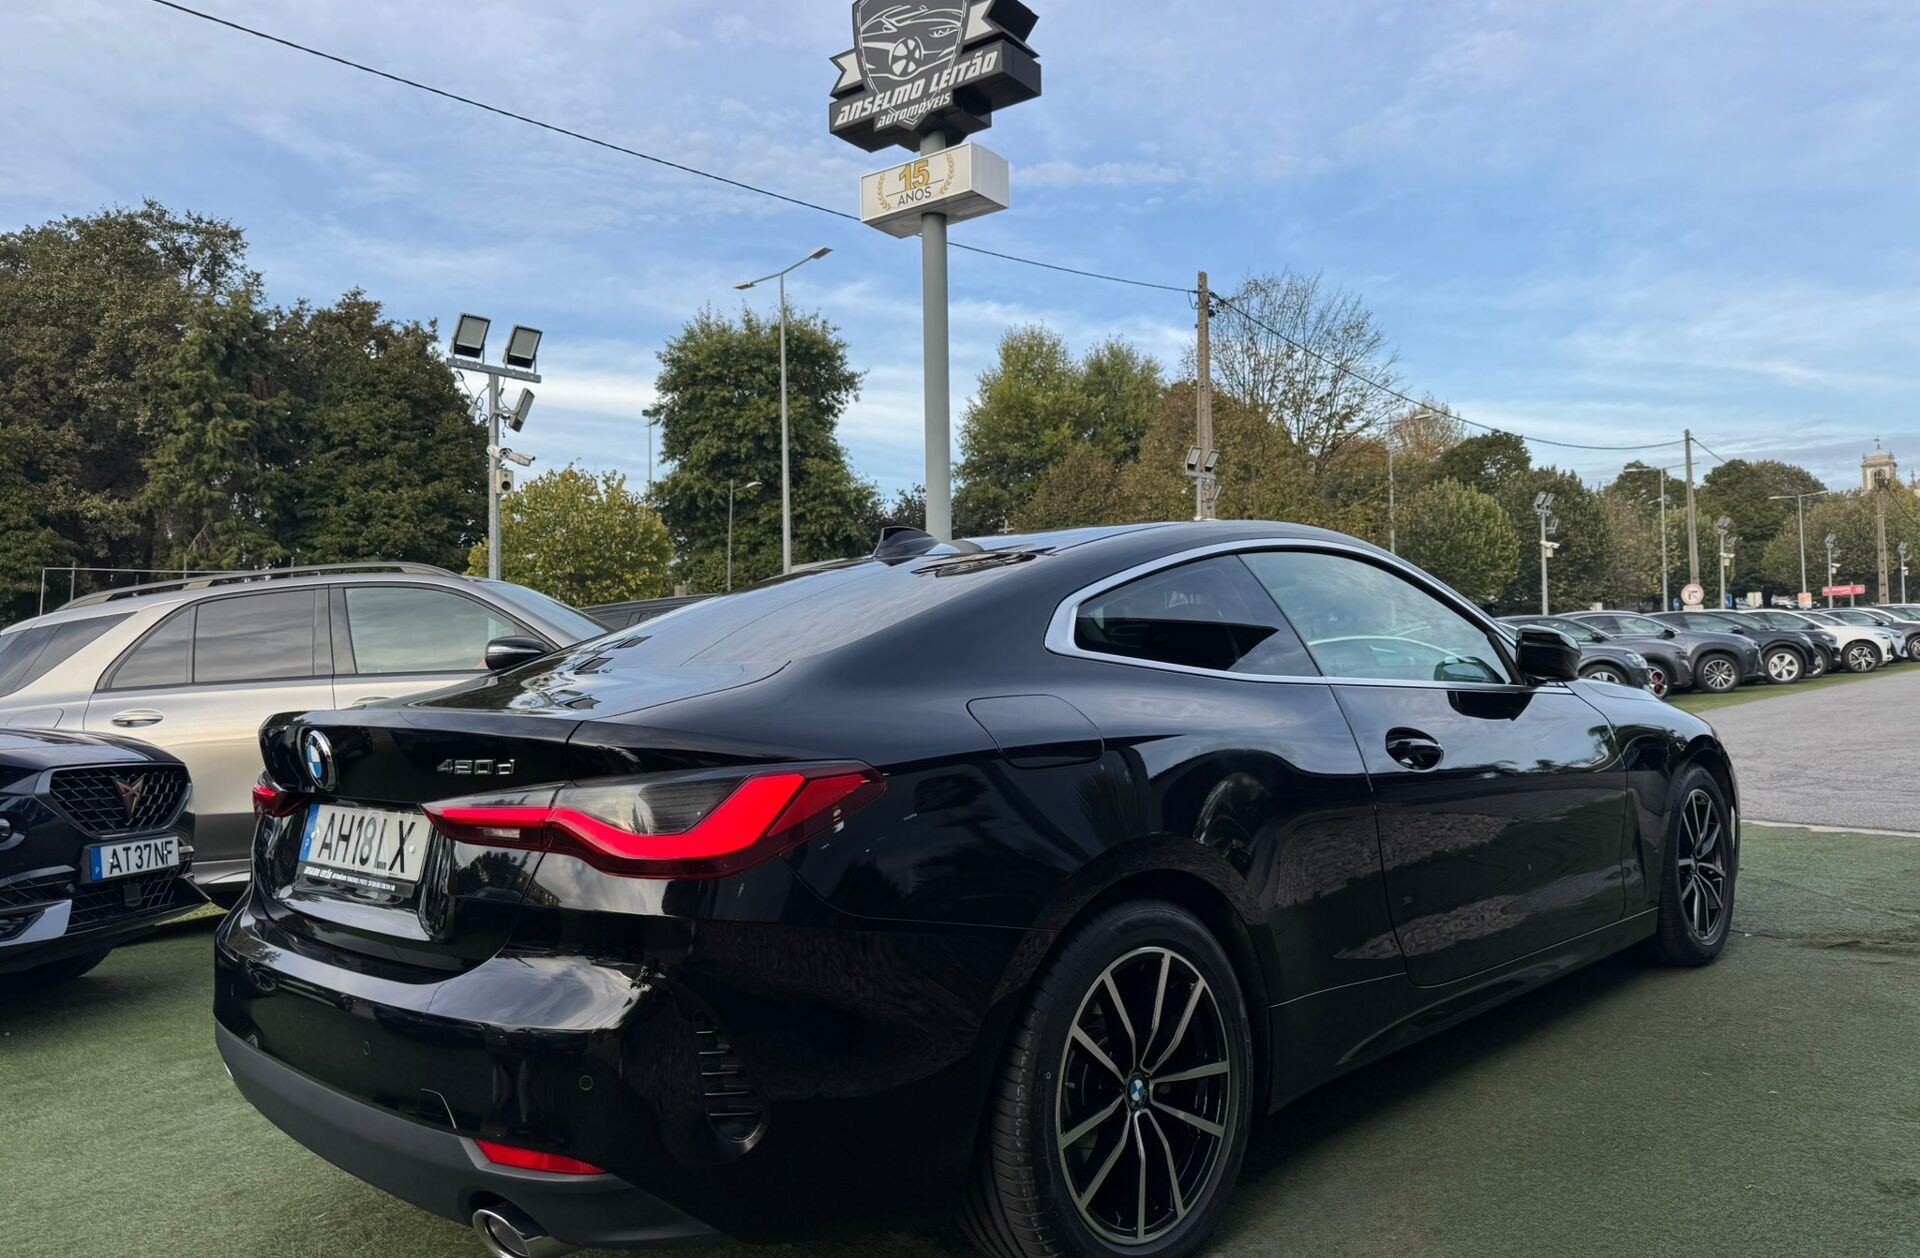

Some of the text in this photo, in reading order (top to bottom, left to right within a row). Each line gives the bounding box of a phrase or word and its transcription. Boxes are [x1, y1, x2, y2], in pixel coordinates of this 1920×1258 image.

[834, 51, 998, 127] ANSELMO LEITÃO
[876, 92, 951, 128] AUTOMÓVEIS
[899, 159, 929, 192] 15
[898, 185, 932, 207] ANOS
